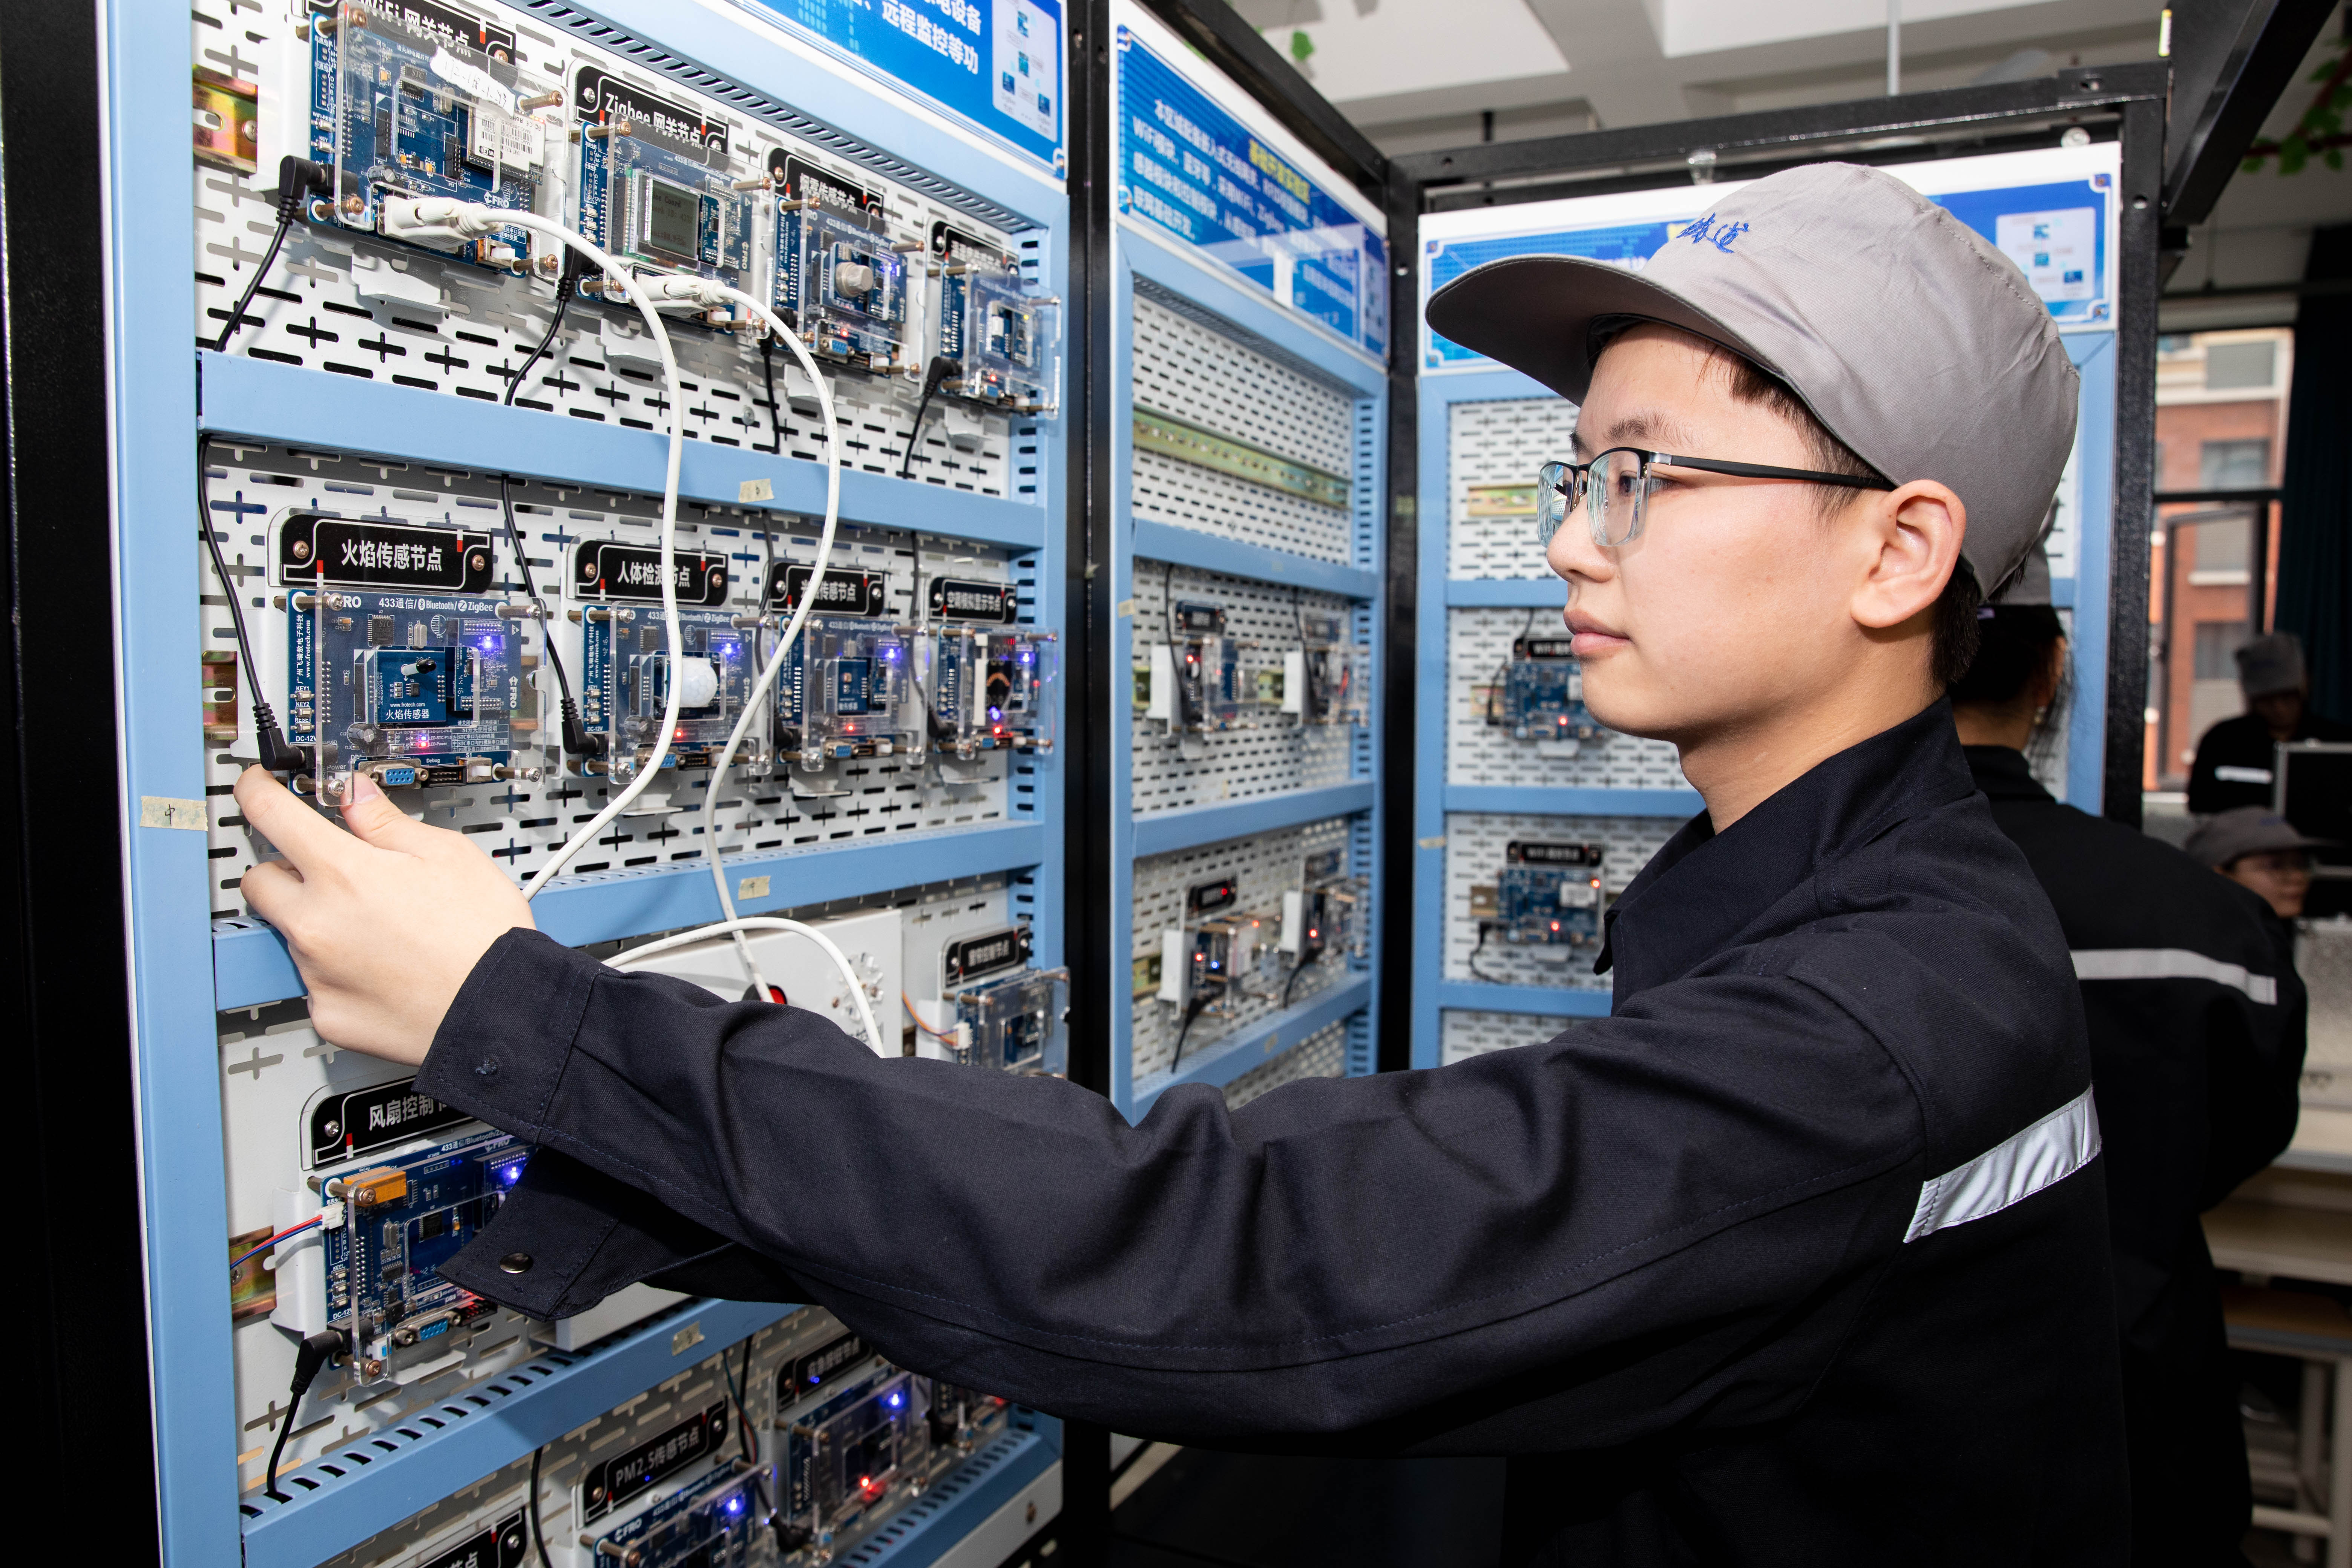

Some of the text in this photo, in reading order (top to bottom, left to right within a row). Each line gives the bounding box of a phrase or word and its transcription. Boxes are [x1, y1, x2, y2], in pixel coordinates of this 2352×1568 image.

[405, 8, 471, 57] 网关节点
[883, 1, 978, 75] 远程监控等功
[412, 68, 423, 78] STC
[313, 112, 336, 123] WIFI-RESET
[605, 92, 703, 150] Zigbee 网关节点
[492, 196, 510, 208] FRO
[341, 539, 442, 572] 火焰传感节点
[800, 579, 856, 601] 光传感节点
[379, 598, 417, 610] 433通信/
[468, 602, 493, 613] ZigBee
[385, 709, 430, 720] 火焰传感器
[616, 1425, 701, 1488] PM2.5传感节点
